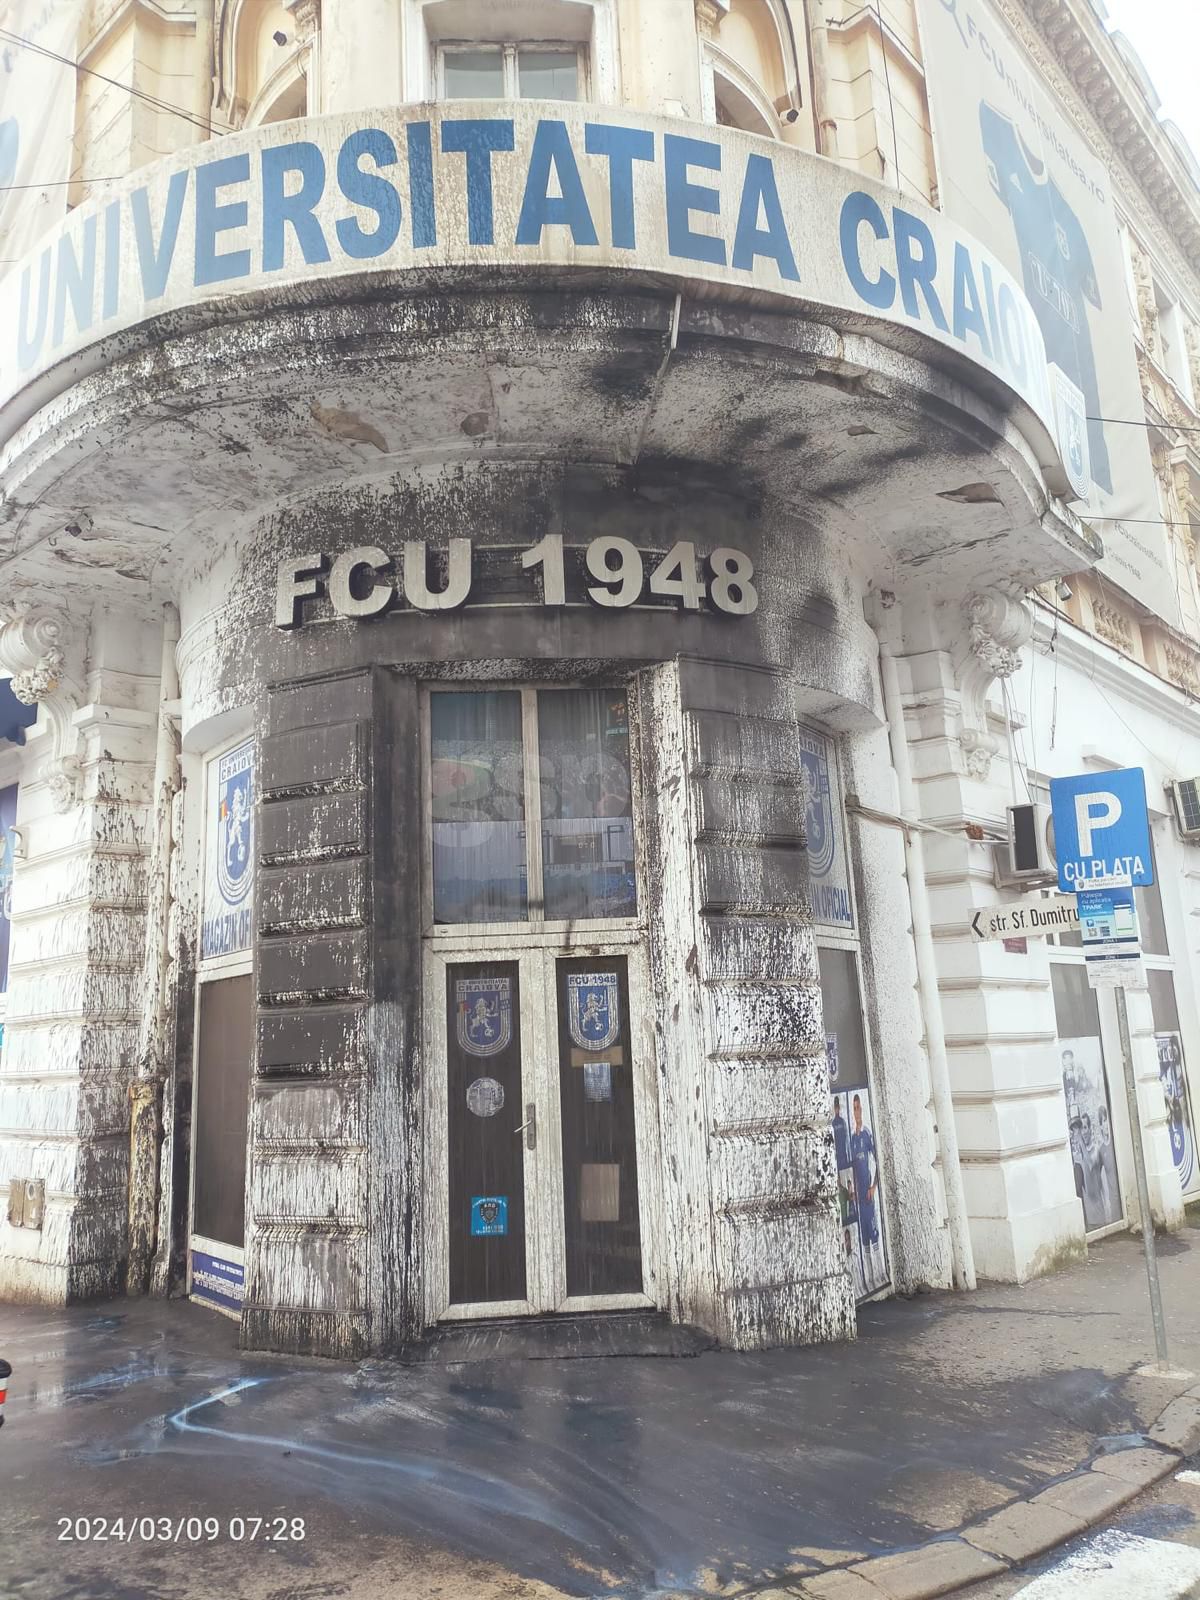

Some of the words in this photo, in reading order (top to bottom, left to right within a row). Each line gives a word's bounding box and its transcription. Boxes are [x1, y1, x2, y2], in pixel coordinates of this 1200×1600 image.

[16, 119, 801, 371] UNIVERSITATEA
[275, 538, 475, 629] FCU
[520, 533, 760, 616] 1948
[1074, 791, 1122, 857] P
[1063, 861, 1086, 881] CU
[1091, 856, 1145, 879] PLATA
[990, 914, 1010, 932] str.
[1011, 910, 1029, 930] Sf.
[1030, 905, 1080, 927] Dumitru
[569, 976, 589, 985] FCU
[592, 975, 616, 984] 1948
